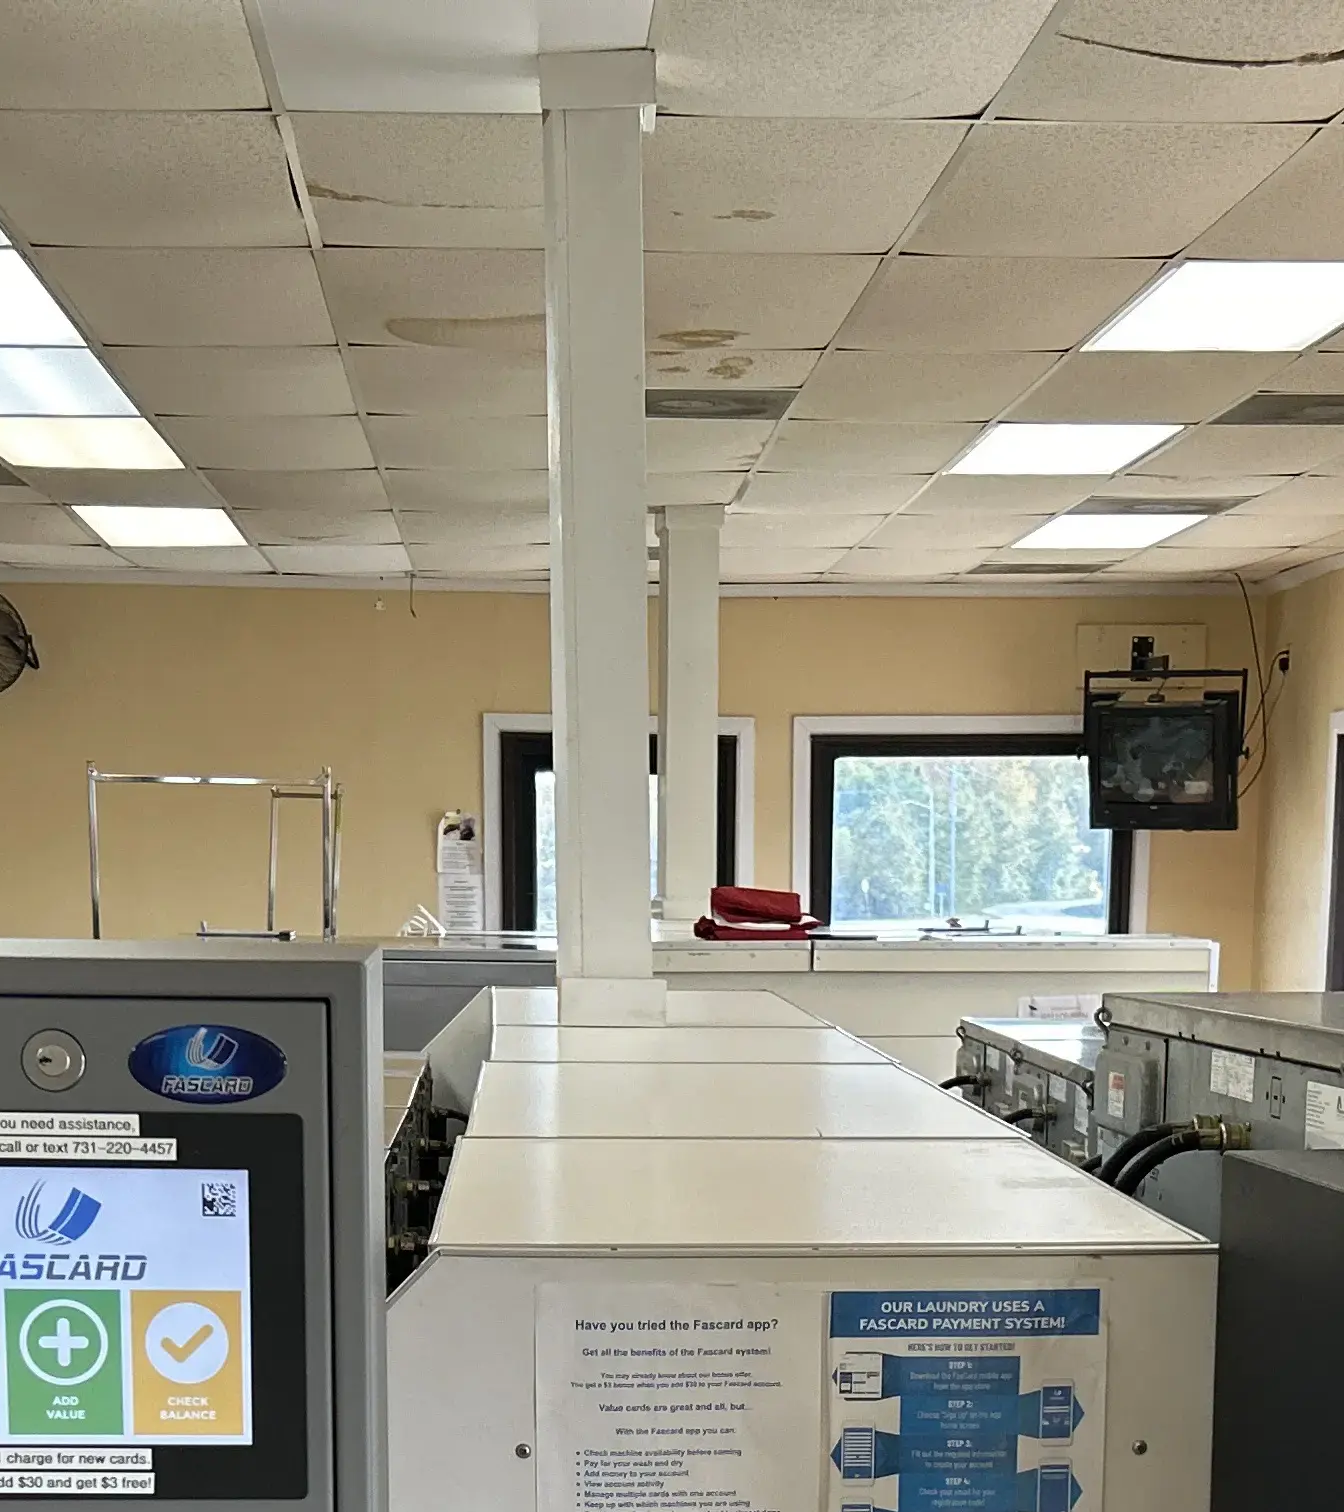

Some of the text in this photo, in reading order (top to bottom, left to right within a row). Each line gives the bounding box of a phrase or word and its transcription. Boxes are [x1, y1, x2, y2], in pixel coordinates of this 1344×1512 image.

[161, 1075, 254, 1095] FASCARD
[21, 1118, 54, 1129] need
[58, 1118, 136, 1133] assistance,
[25, 1143, 39, 1153] or
[43, 1142, 68, 1154] text
[881, 1300, 1045, 1313] OUR LAUNDRY USES A
[575, 1319, 778, 1333] Have you tried the Fascard app?
[859, 1317, 1065, 1330] FASCARD PAYMENT SYSTEM!
[601, 1348, 611, 1356] all
[614, 1348, 628, 1356] the
[631, 1348, 666, 1356] benefits
[669, 1348, 679, 1356] of
[735, 1348, 771, 1357] system!
[53, 1396, 79, 1406] ADD
[167, 1397, 208, 1406] CHECK
[599, 1404, 623, 1412] Value
[626, 1404, 651, 1412] cards
[670, 1404, 693, 1413] great
[46, 1410, 86, 1420] VALUE
[160, 1410, 216, 1420] BALANCE
[6, 1452, 53, 1467] charge
[57, 1452, 75, 1464] for
[79, 1455, 106, 1464] new
[109, 1452, 150, 1465] cards.
[18, 1476, 43, 1489] $30
[47, 1477, 72, 1488] and
[76, 1477, 98, 1490] get
[101, 1477, 118, 1489] $3
[122, 1477, 152, 1489] free!
